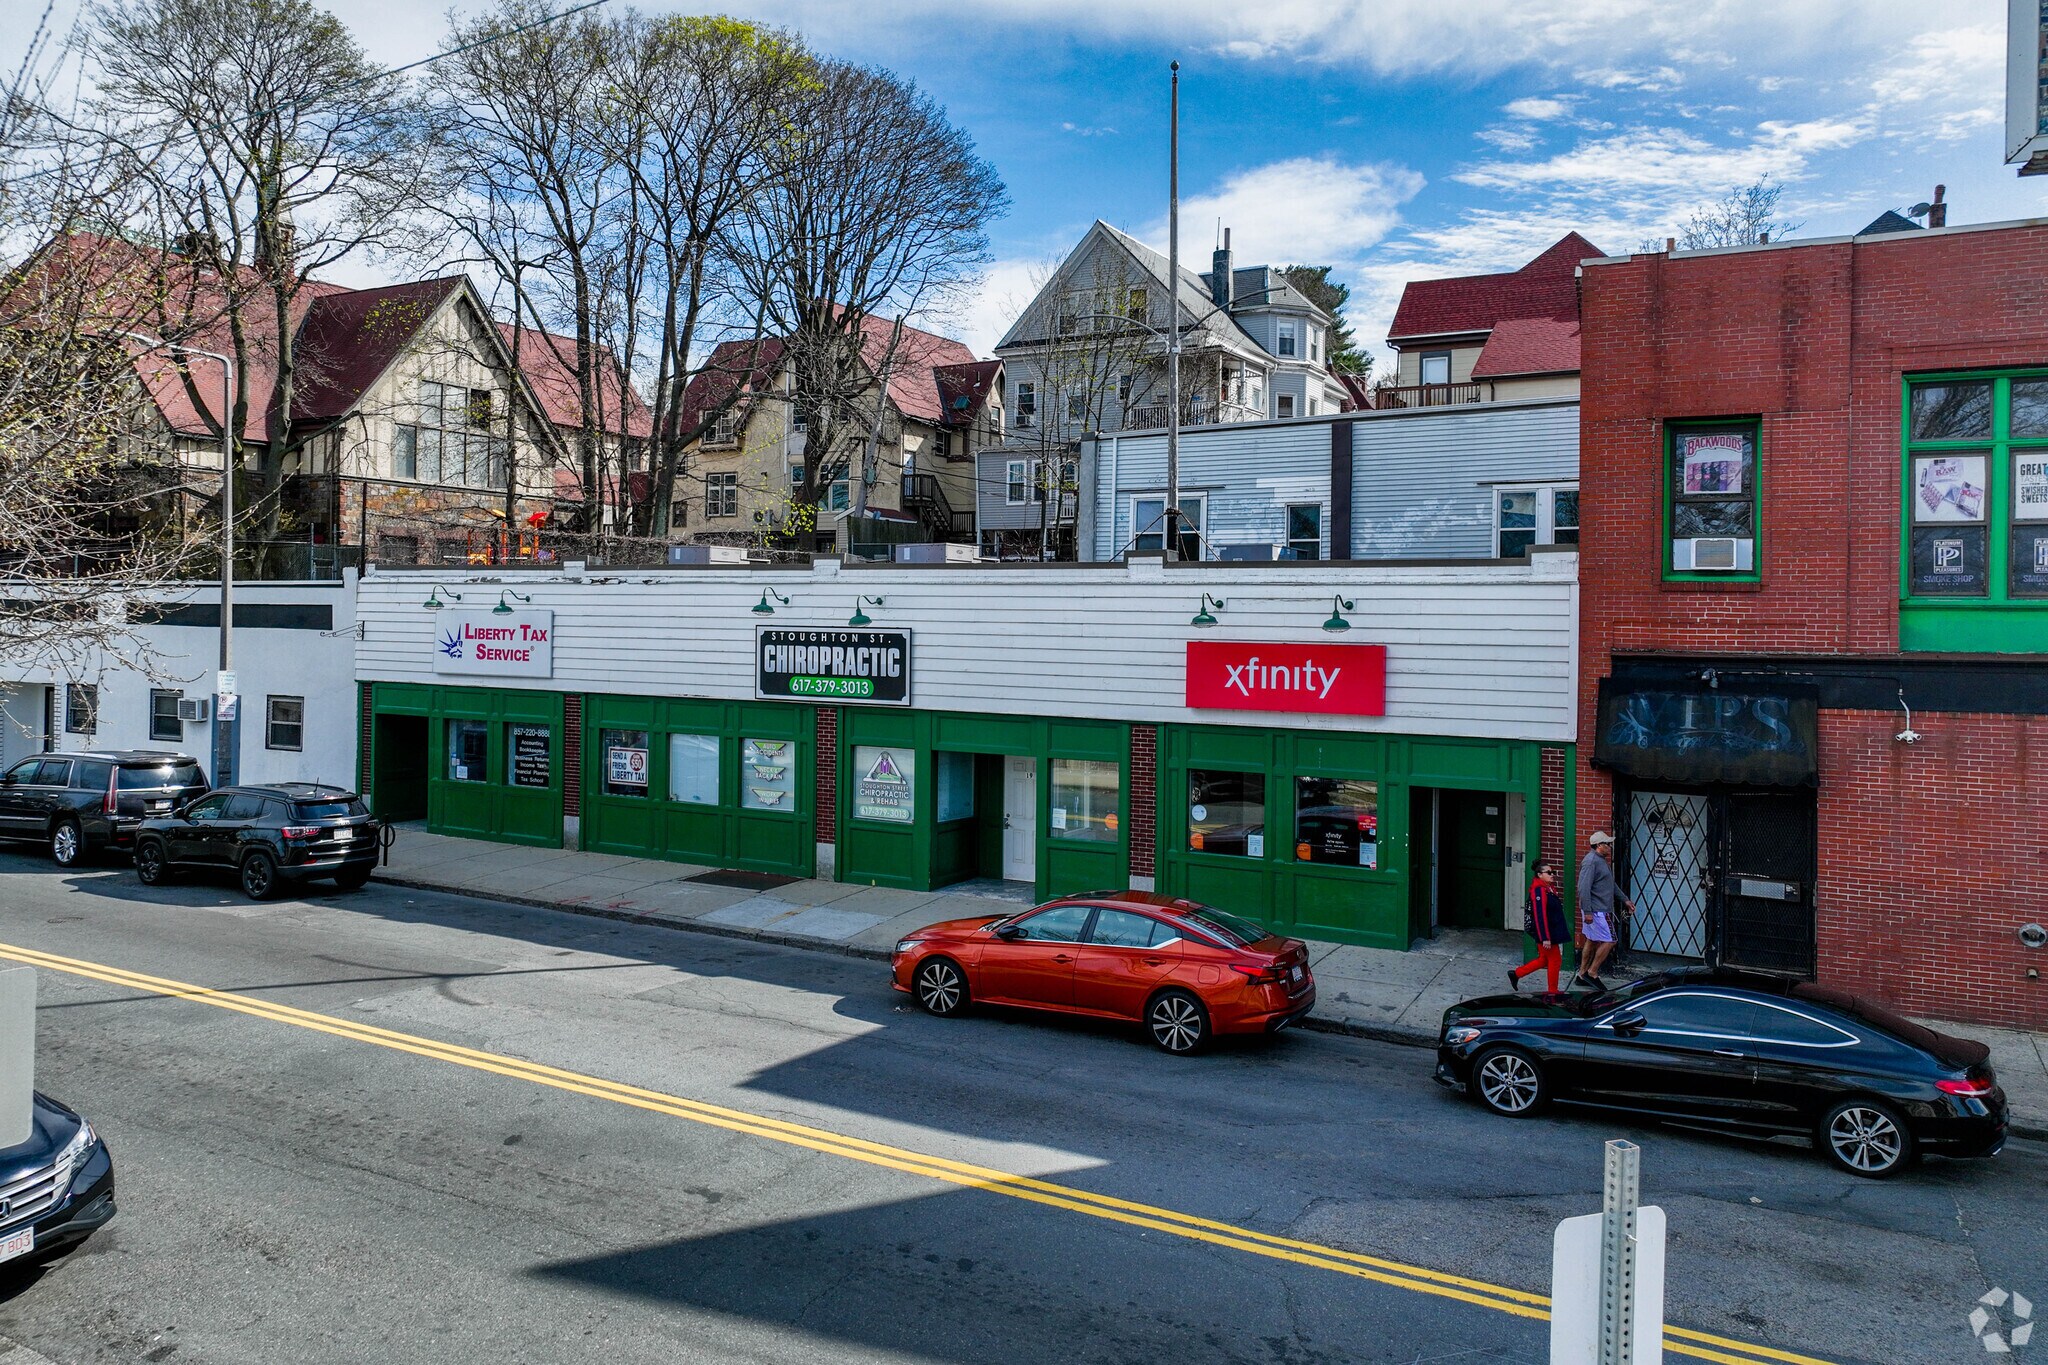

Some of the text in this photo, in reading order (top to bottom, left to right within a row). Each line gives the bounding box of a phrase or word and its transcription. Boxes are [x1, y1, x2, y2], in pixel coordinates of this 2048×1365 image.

[1686, 436, 1742, 456] BACKWOODS
[1936, 466, 1956, 476] RAW
[2020, 463, 2048, 476] GREAT
[2020, 494, 2048, 504] SWEETS
[1923, 574, 1974, 583] SMOKE SHOP
[465, 623, 548, 642] LIBERTY TAX
[771, 631, 891, 643] STOUGHTON ST.
[764, 644, 900, 678] CHIROPRACTIC
[1224, 657, 1342, 699] xfinity
[792, 679, 869, 695] 617-379-3013
[521, 740, 544, 748] Accounting
[519, 747, 546, 755] Bookkeeping
[612, 752, 624, 760] SEND
[624, 752, 628, 760] A
[612, 762, 627, 770] FRIEND
[612, 771, 645, 782] LIBERTY TAX
[860, 789, 909, 799] CHIROPRACTIC
[860, 806, 908, 818] 617-379-3013
